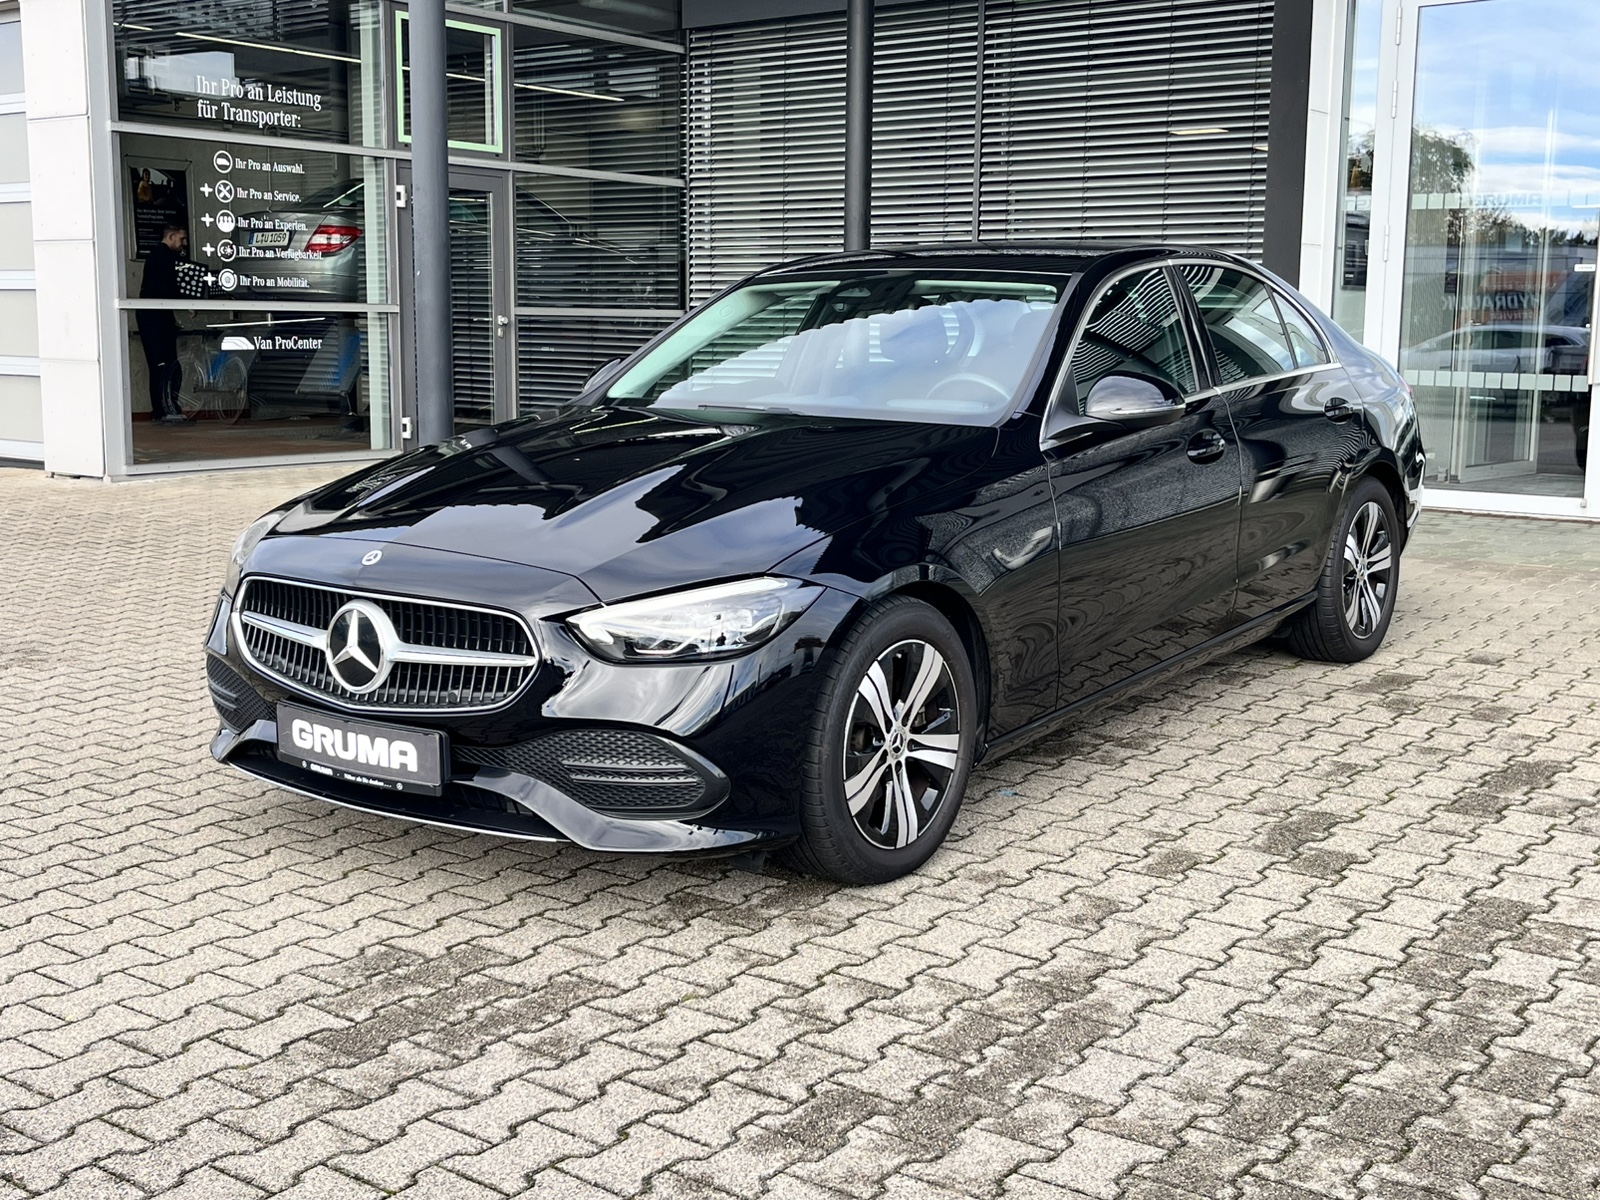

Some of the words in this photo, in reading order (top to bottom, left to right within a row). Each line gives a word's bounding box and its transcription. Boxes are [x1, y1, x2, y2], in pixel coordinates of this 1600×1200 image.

[196, 75, 217, 94] Ihr
[221, 78, 243, 98] Pro
[247, 86, 264, 101] an
[267, 84, 322, 112] Leistung
[197, 99, 218, 119] für
[221, 101, 301, 128] Transporter:
[235, 158, 246, 169] Ihr
[248, 159, 260, 170] Pro
[262, 162, 271, 171] an
[273, 161, 305, 174] Auswahl.
[236, 187, 248, 198] Ihr
[249, 188, 261, 200] Pro
[263, 192, 272, 200] an
[274, 190, 301, 203] Service.
[238, 216, 249, 228] Ihr
[250, 217, 263, 229] Pro
[264, 220, 273, 229] an
[275, 219, 308, 233] Experten.
[239, 246, 250, 257] Ihr
[251, 247, 264, 258] Pro
[265, 249, 274, 258] an
[276, 247, 324, 261] Verfügbarkeit.
[240, 274, 251, 286] Ihr
[252, 276, 264, 287] Pro
[266, 278, 275, 288] an
[277, 275, 310, 288] Mobilität.
[253, 336, 272, 350] Van
[275, 335, 323, 350] ProCenter
[291, 718, 418, 773] GRUMA
